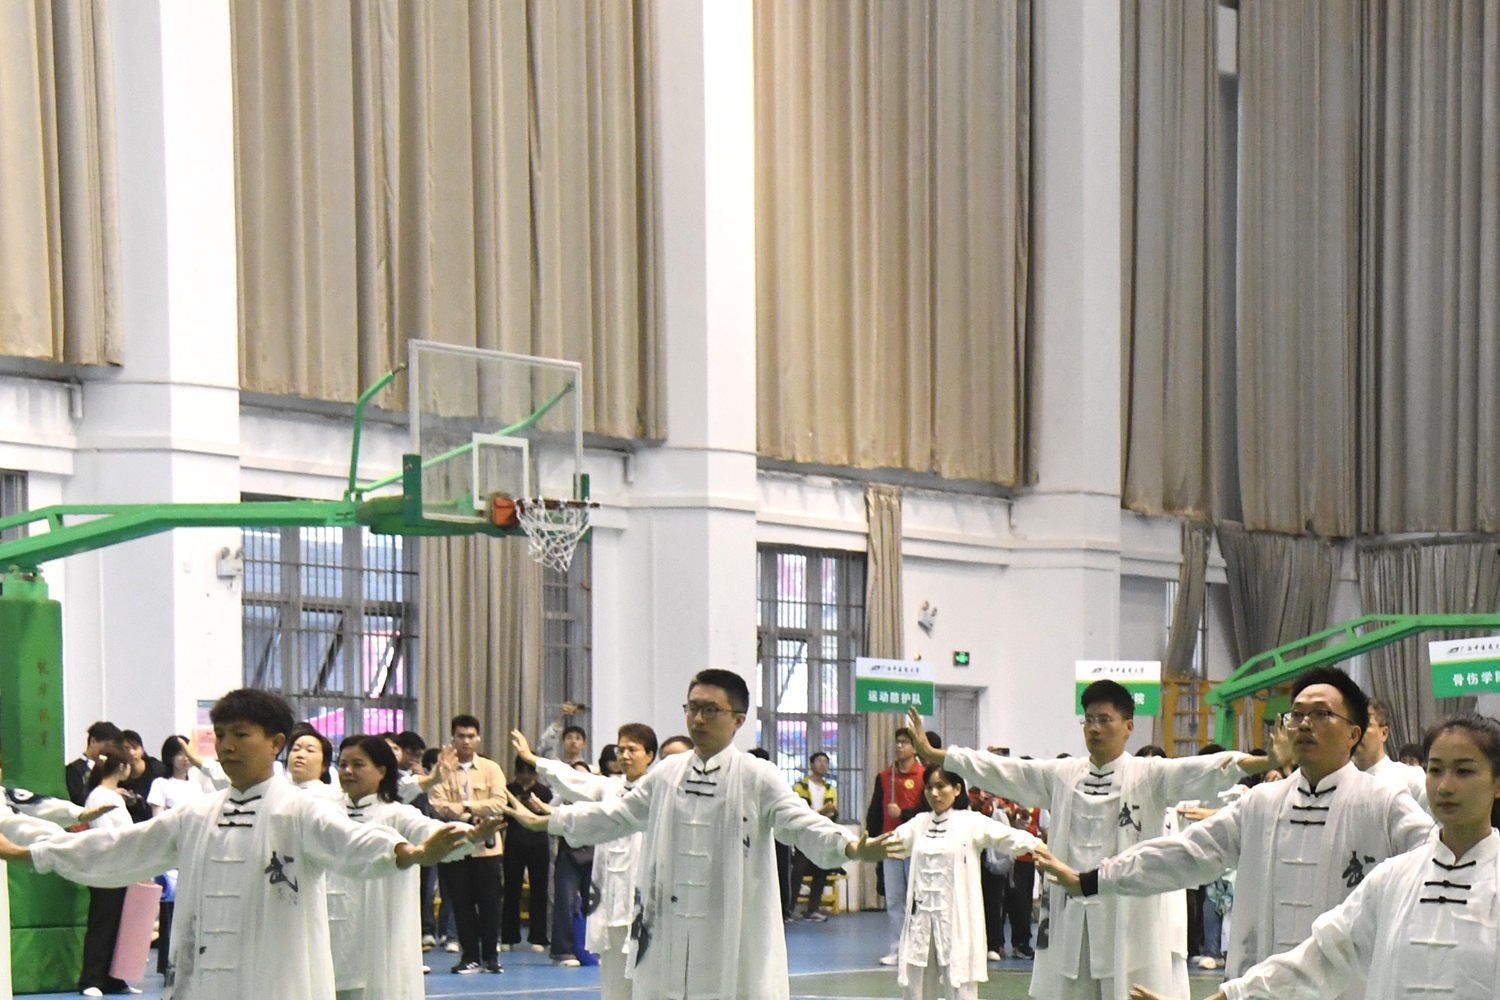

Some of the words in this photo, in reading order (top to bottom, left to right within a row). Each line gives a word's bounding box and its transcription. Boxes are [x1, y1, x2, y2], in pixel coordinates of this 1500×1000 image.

[868, 690, 922, 706] 运动防护队
[265, 851, 298, 893] 武
